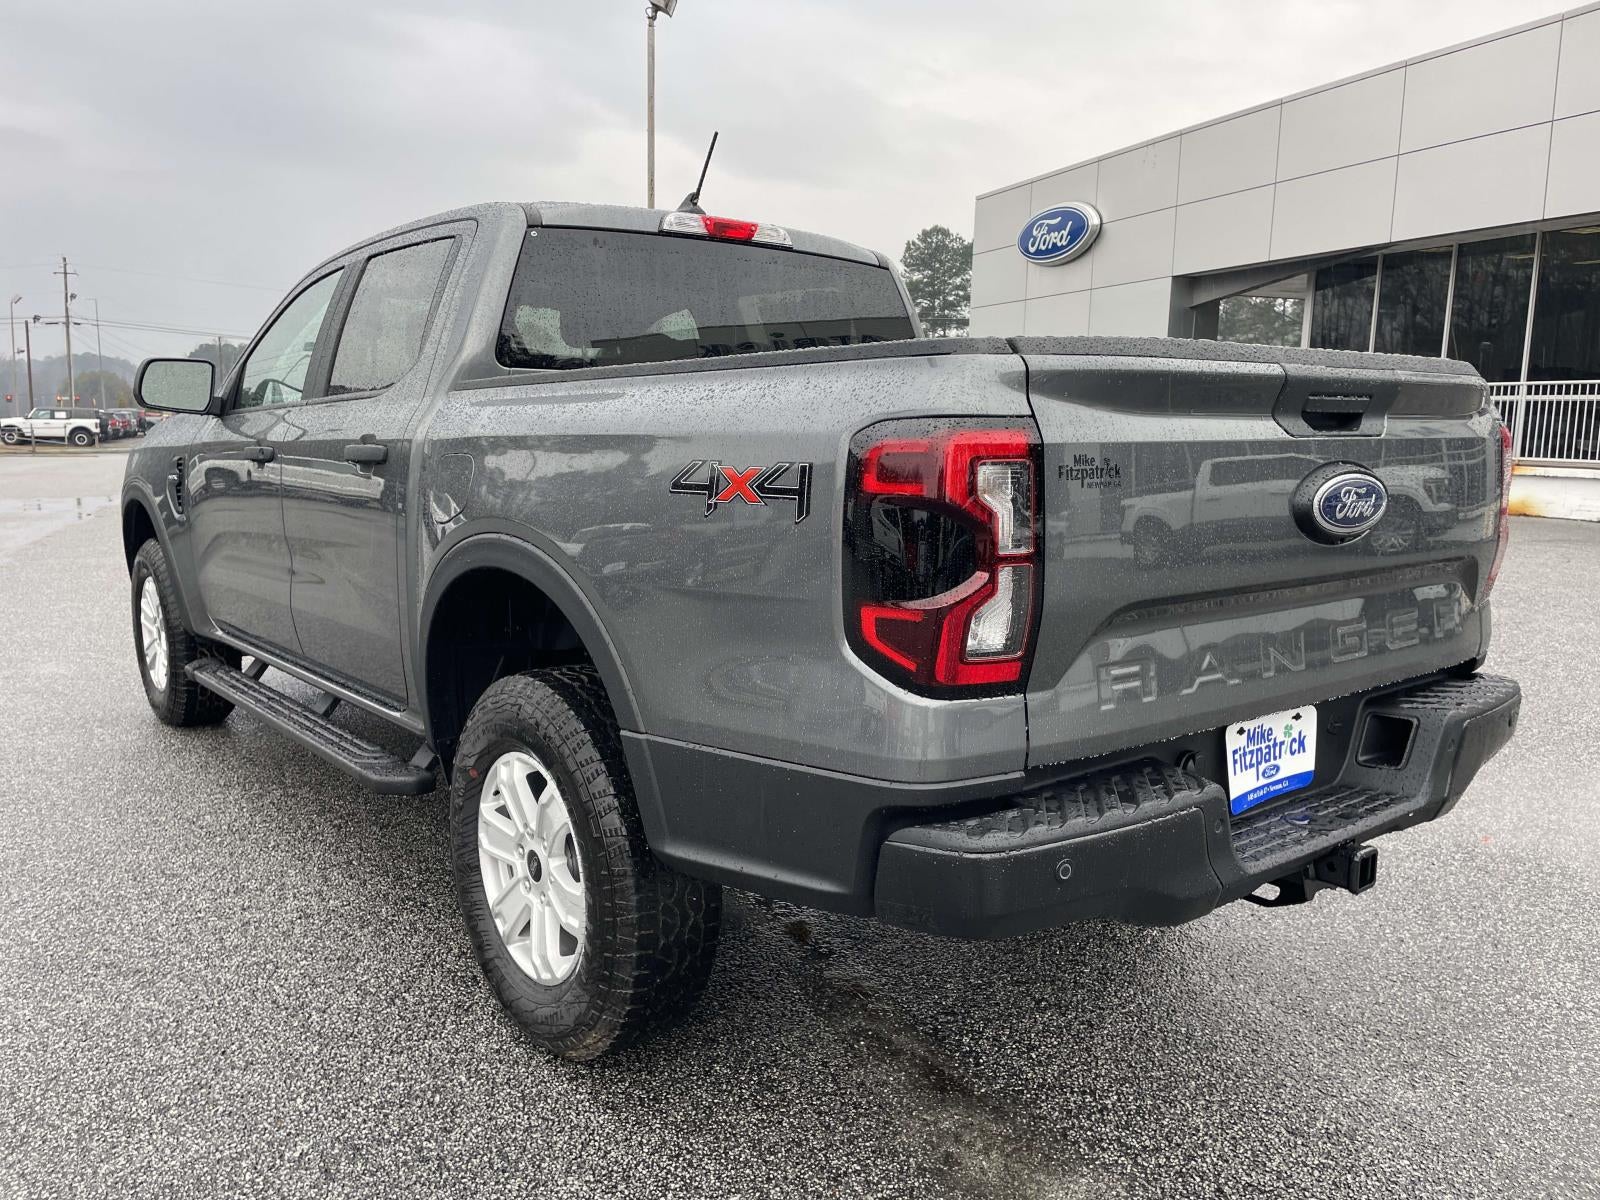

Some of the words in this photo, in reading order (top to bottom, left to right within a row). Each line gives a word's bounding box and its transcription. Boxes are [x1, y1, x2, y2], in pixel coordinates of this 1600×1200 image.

[1028, 216, 1073, 254] Ford
[1058, 464, 1121, 488] Fitzpatrick
[1073, 454, 1096, 467] Mike
[1335, 486, 1376, 519] Ford
[1097, 600, 1464, 710] RANGER
[1246, 723, 1274, 749] Mike
[1231, 729, 1307, 783] Fitzpatrick
